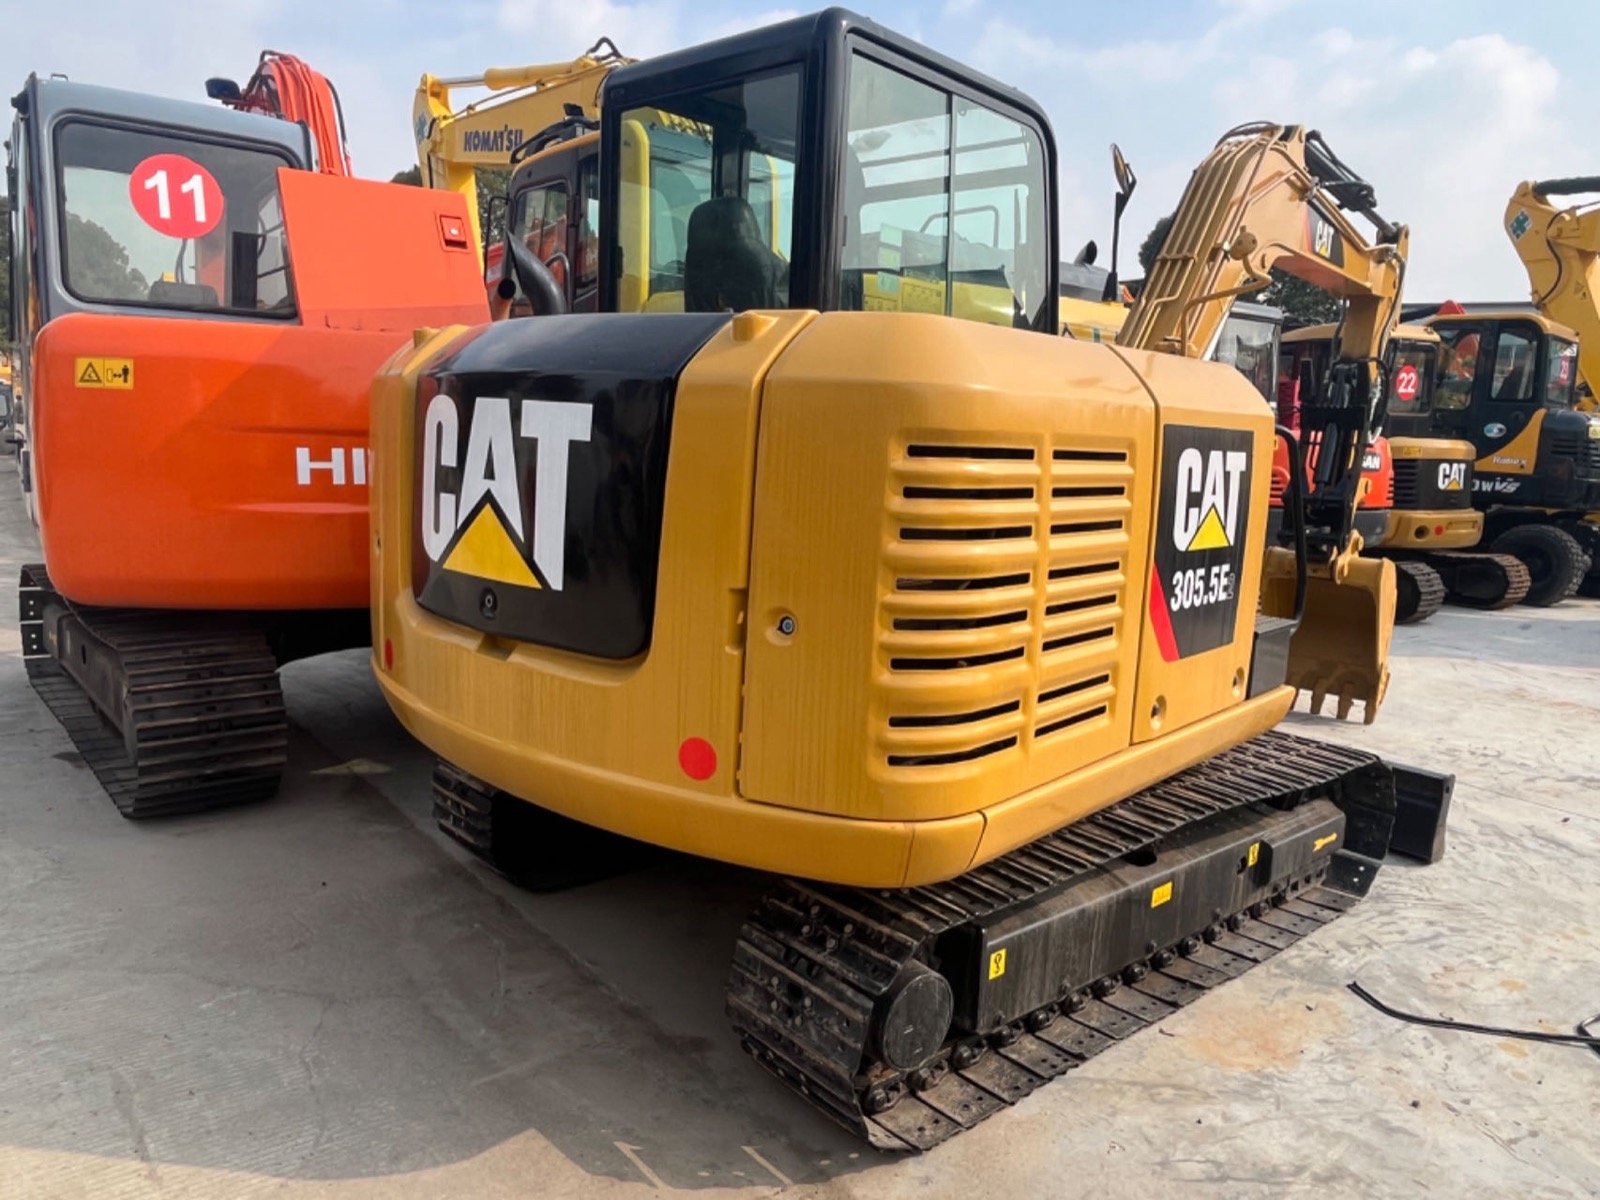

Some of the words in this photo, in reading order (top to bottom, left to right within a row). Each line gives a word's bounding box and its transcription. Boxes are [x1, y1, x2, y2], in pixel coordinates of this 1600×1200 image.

[464, 124, 522, 152] KOMATSU
[144, 169, 206, 223] 11
[1315, 220, 1334, 258] CAT
[1398, 372, 1416, 393] 22
[296, 447, 370, 485] HI
[1437, 462, 1466, 490] CAT
[422, 394, 593, 591] CAT
[1173, 448, 1247, 552] CAT
